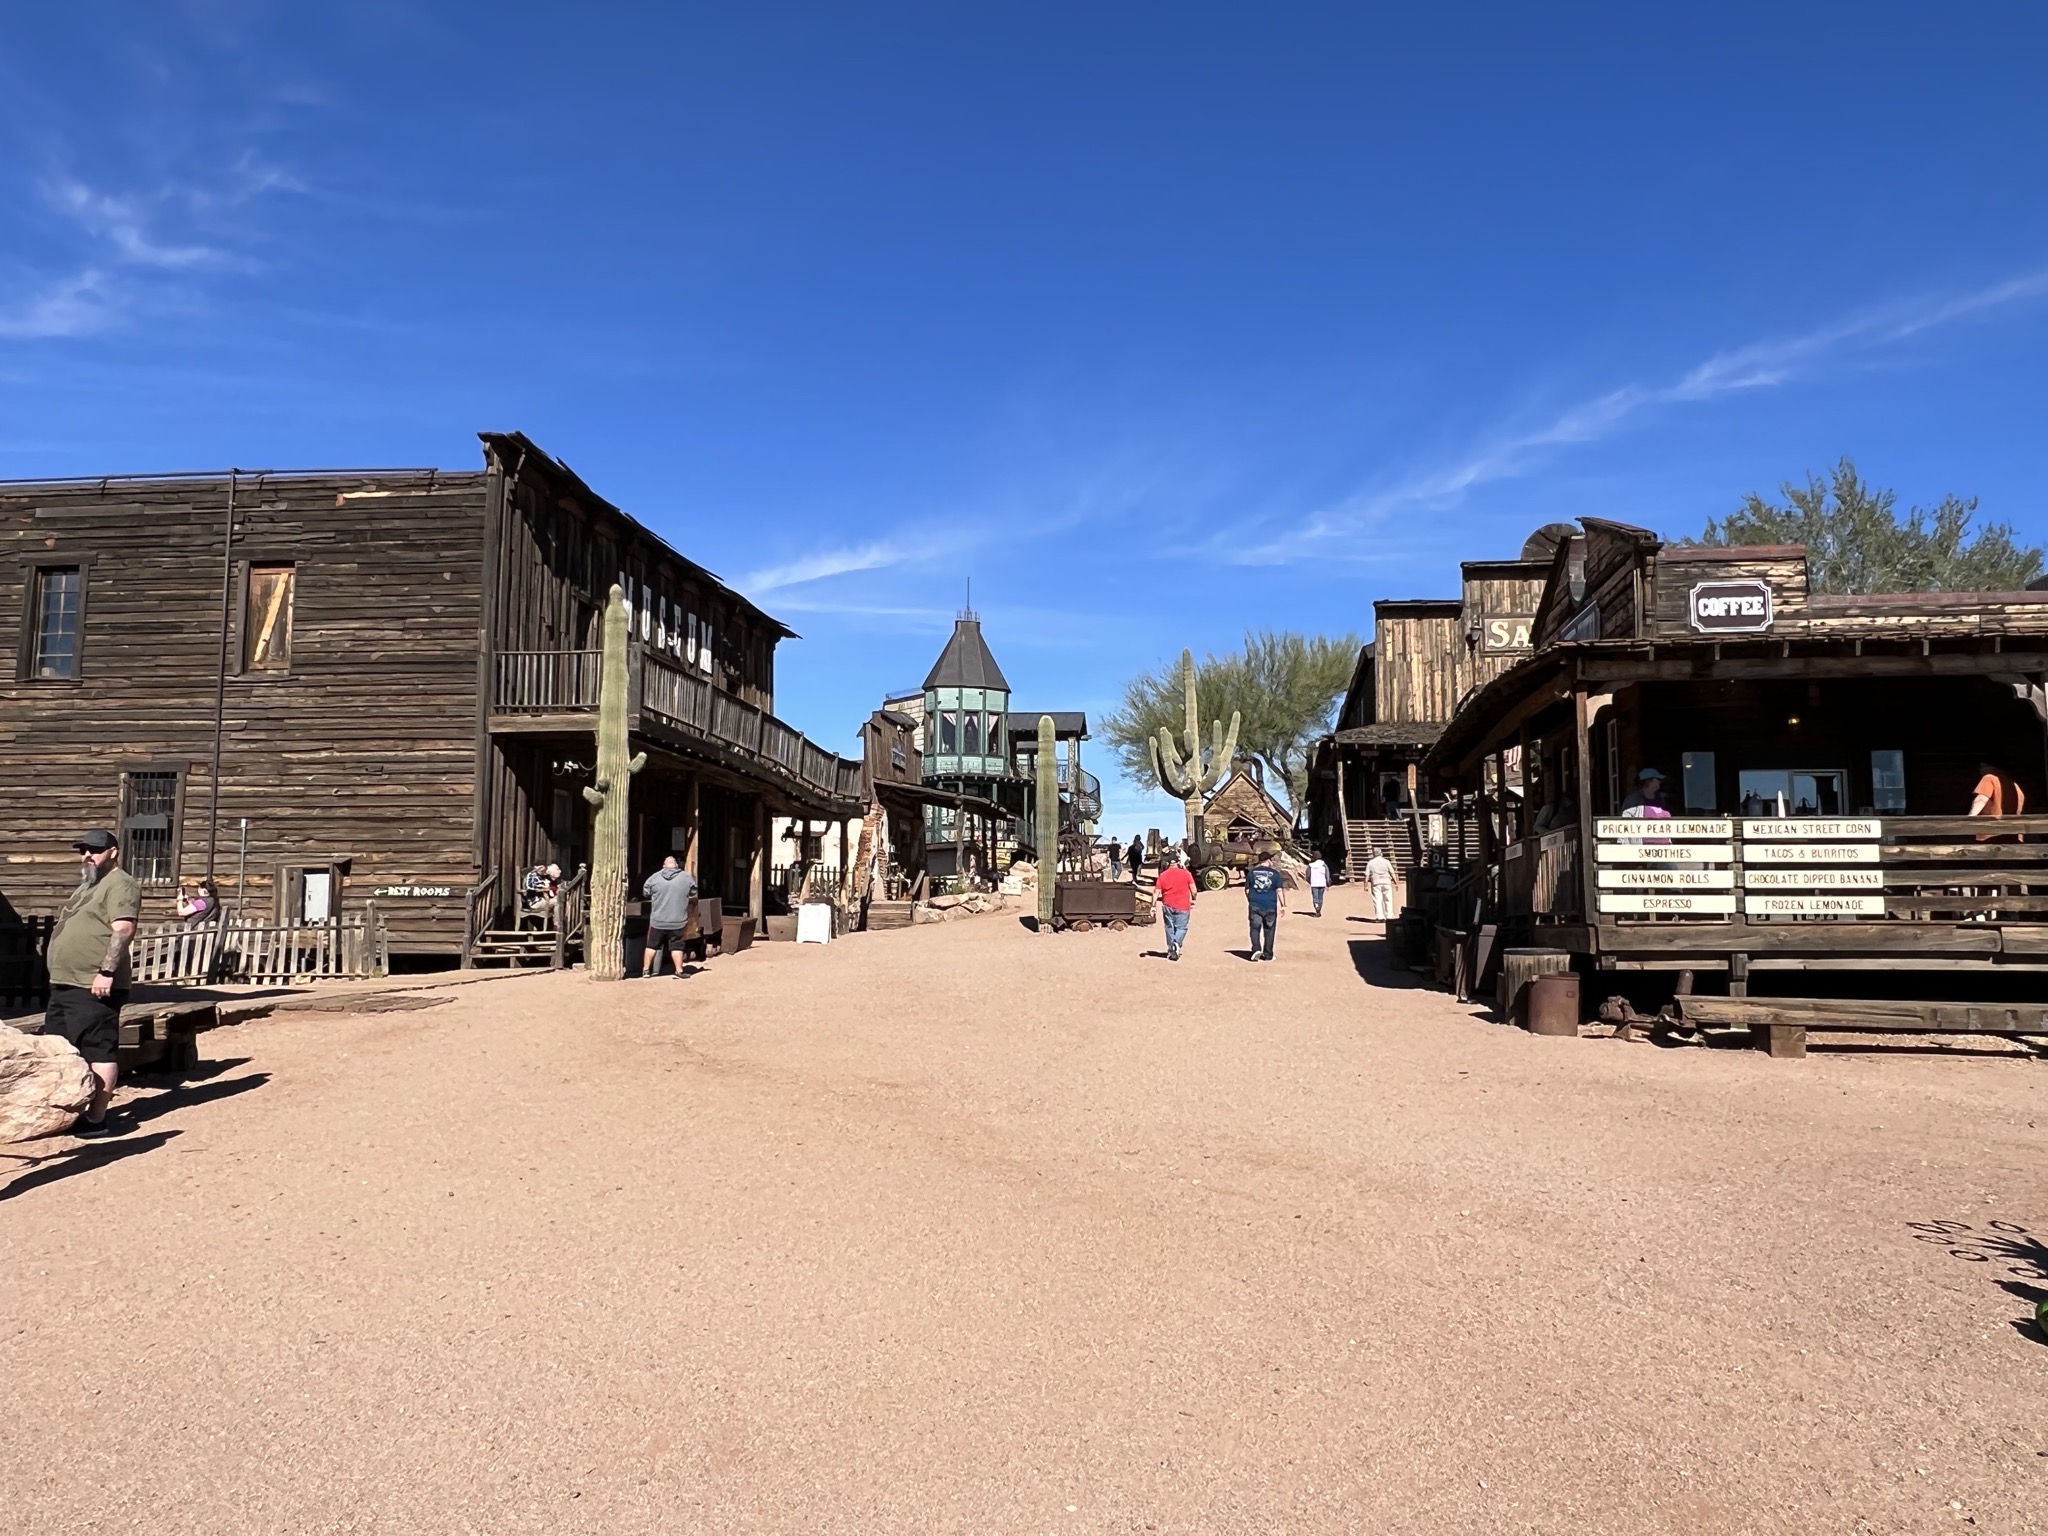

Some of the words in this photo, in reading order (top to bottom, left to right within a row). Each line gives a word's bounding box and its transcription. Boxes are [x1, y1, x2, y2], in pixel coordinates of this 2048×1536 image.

[1698, 596, 1765, 617] COFFEE
[619, 571, 713, 674] MUSEUM
[1487, 621, 1534, 648] SA
[1602, 824, 1642, 834] PRICKLY
[1647, 824, 1672, 834] PEAR
[1676, 824, 1728, 834] LEMONADE
[1752, 824, 1798, 834] MEXICAN
[1802, 824, 1841, 834] STREET
[1846, 824, 1872, 834] CORN
[1638, 849, 1692, 859] SMOOTHIES
[1764, 849, 1794, 859] TACOS
[1798, 849, 1805, 859] &
[1811, 849, 1859, 859] BURRITOS
[1622, 874, 1674, 884] CINNAMON
[1679, 874, 1710, 884] ROLLS
[1748, 874, 1799, 884] CHOCOLATE
[1803, 874, 1836, 884] DIPPED
[1840, 874, 1879, 884] BANANA
[387, 886, 411, 897] REST
[413, 886, 450, 897] ROOMS
[1643, 899, 1692, 909] ESPRESSO
[1765, 900, 1804, 910] FROZEN
[1810, 900, 1864, 910] LEMONADE
